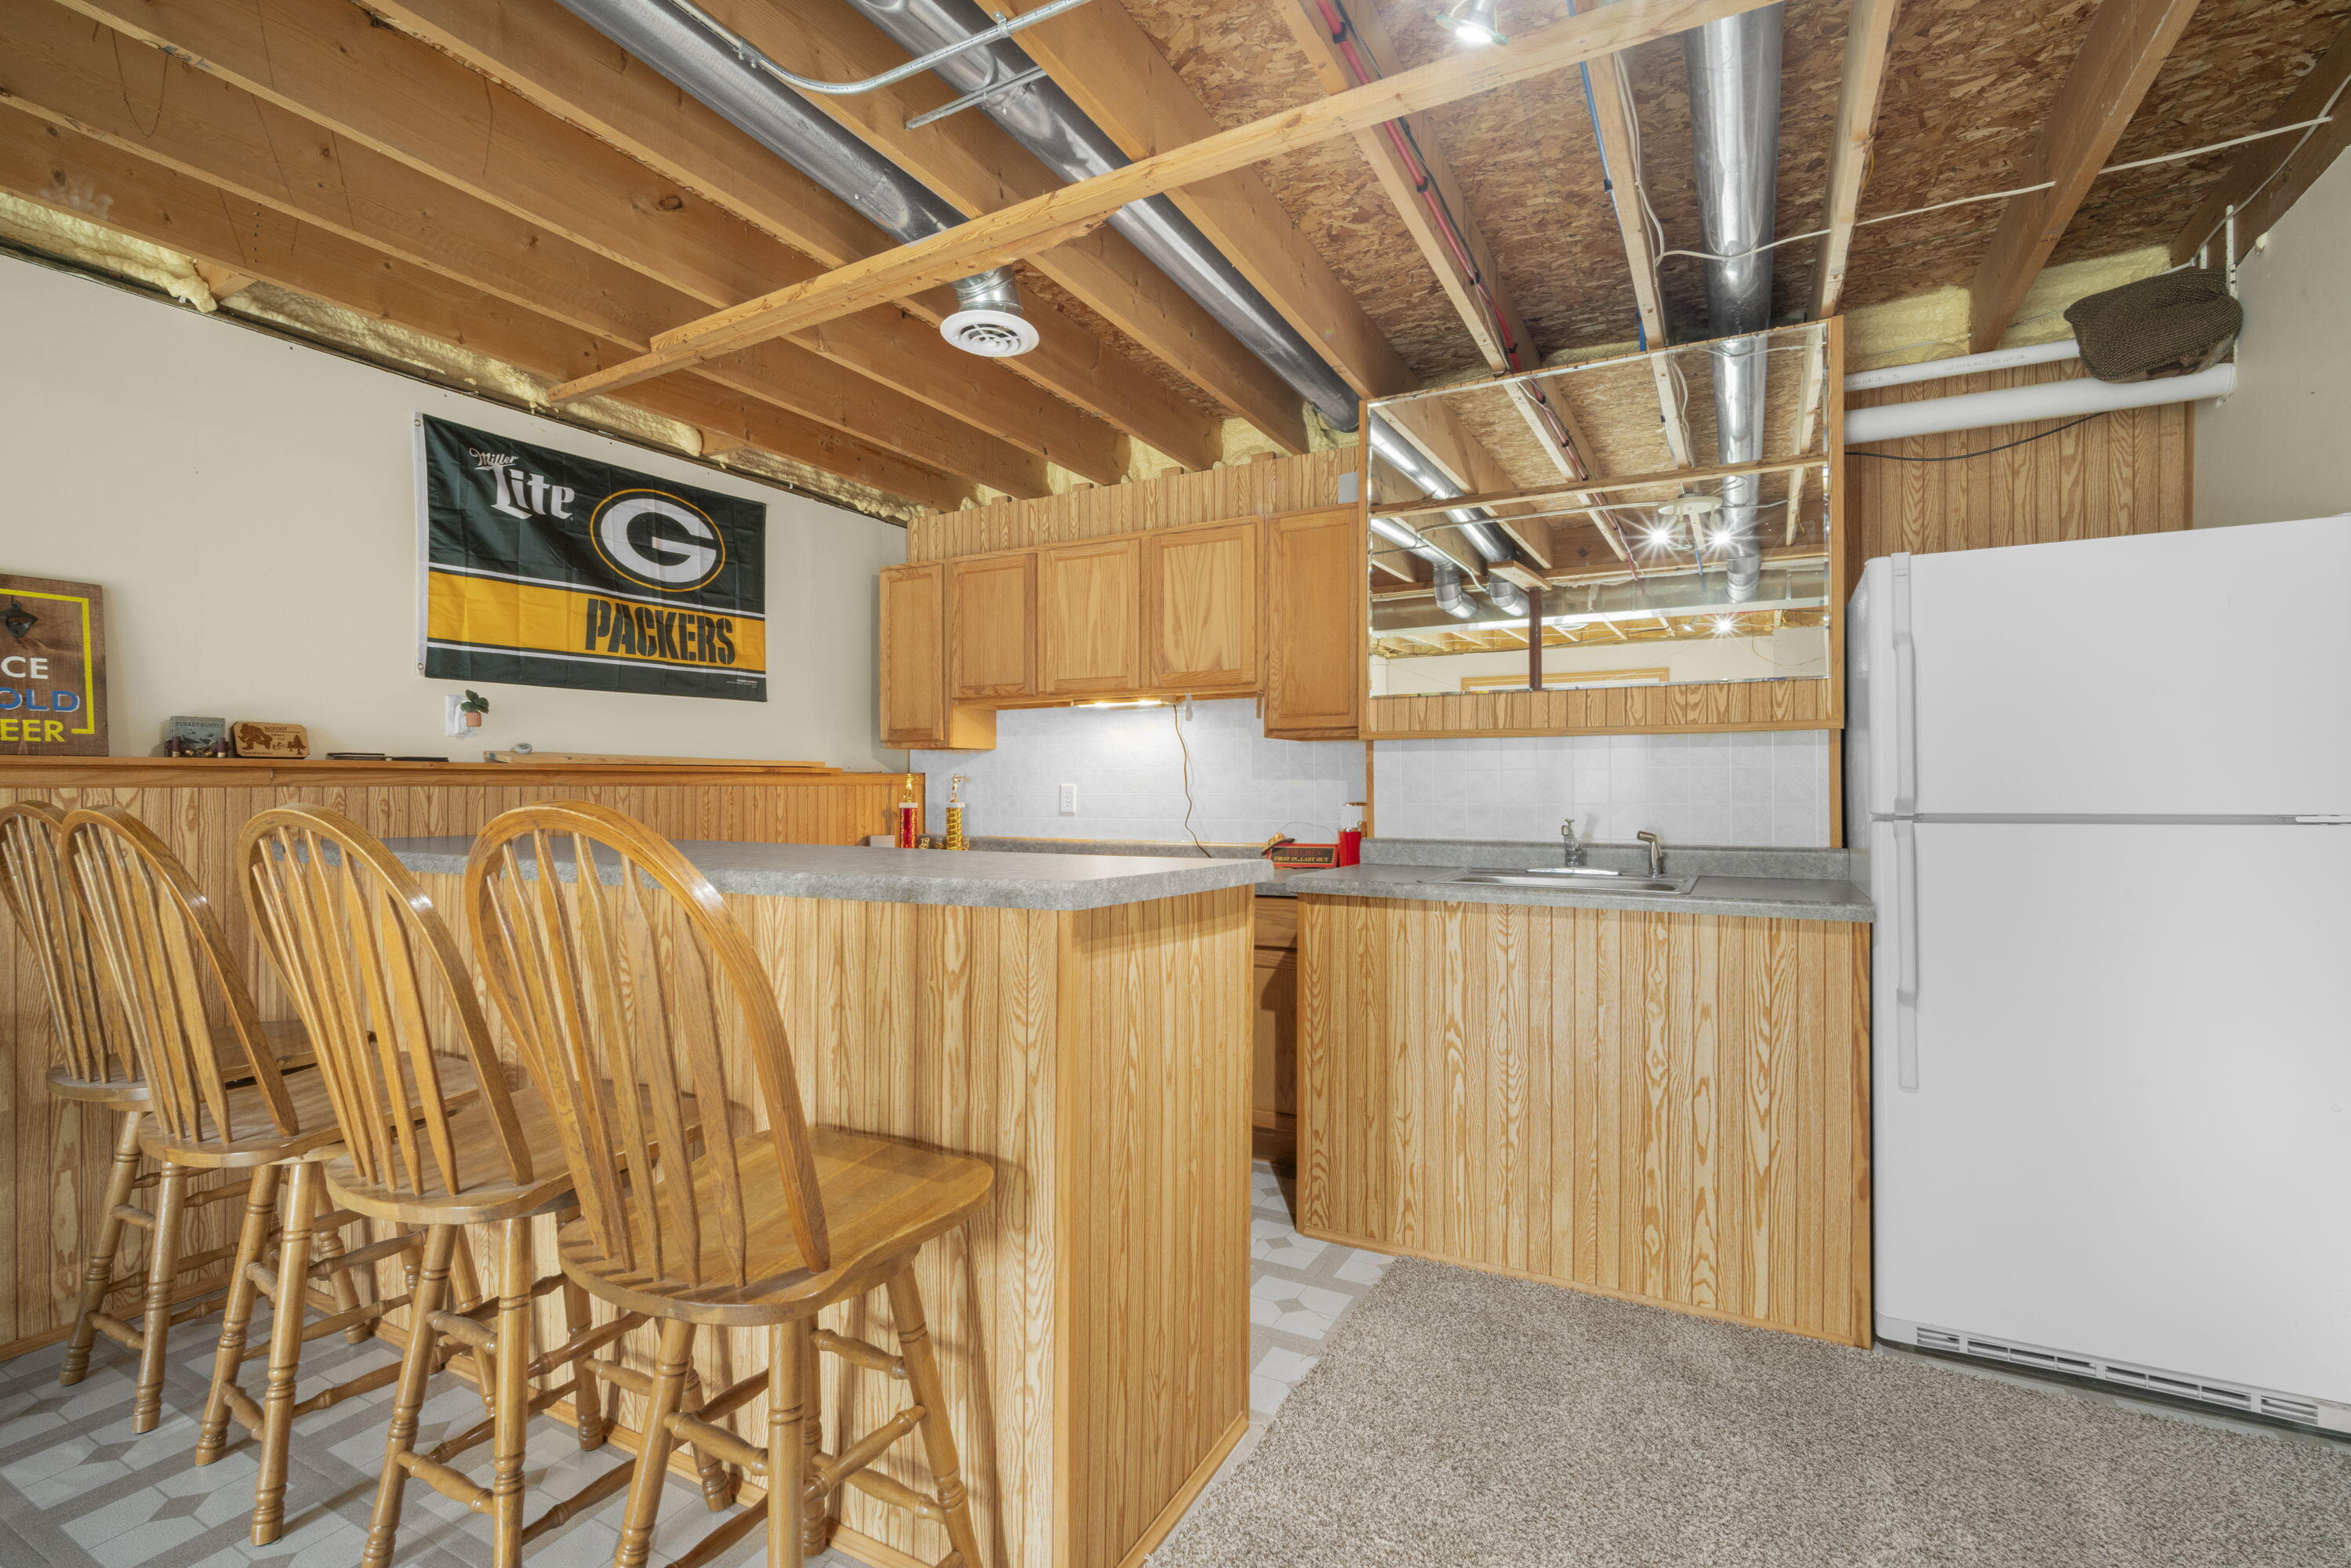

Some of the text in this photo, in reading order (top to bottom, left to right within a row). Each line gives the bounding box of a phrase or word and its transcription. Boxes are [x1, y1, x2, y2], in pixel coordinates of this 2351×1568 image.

[469, 448, 518, 466] Miller
[474, 465, 575, 520] Lite
[601, 499, 717, 583] G
[585, 598, 736, 665] PACKERS
